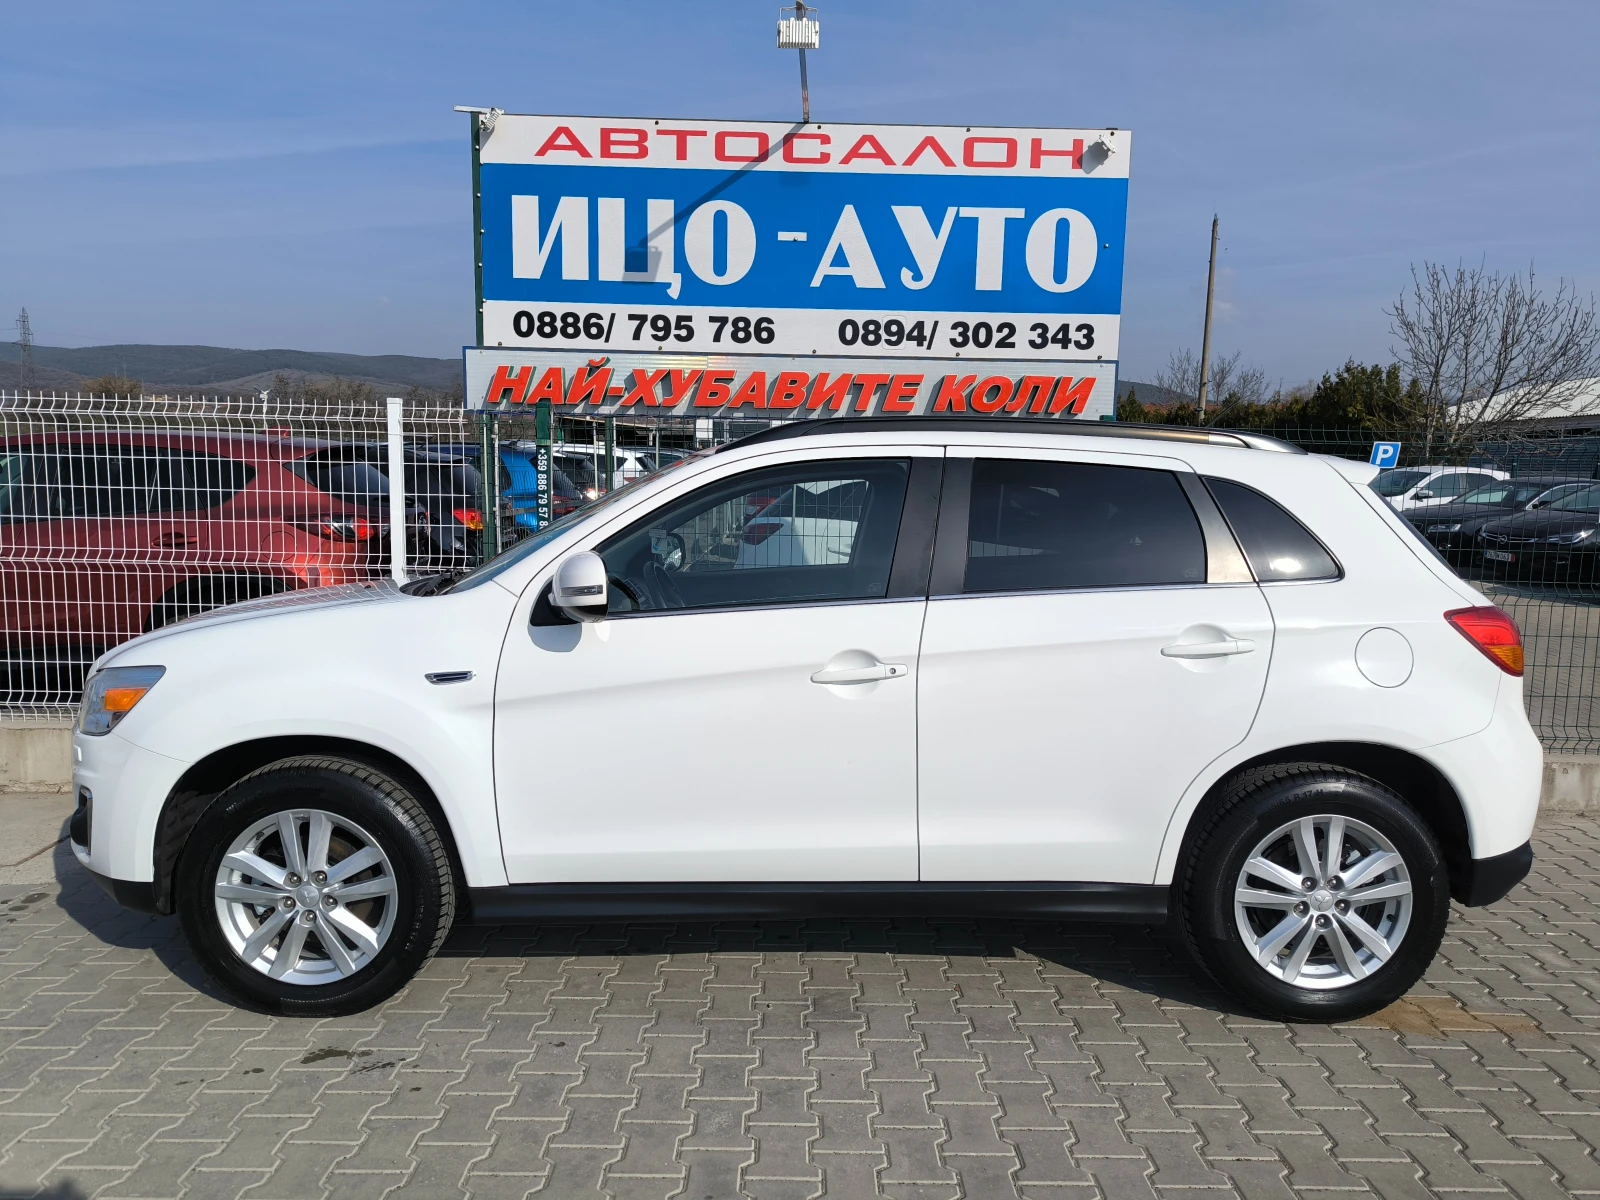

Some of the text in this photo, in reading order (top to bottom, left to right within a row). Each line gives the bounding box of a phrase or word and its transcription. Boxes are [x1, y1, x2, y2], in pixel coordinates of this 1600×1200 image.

[535, 126, 1084, 171] АВТОСАЛОН
[513, 311, 1095, 351] 0886/ 795 786 0894/ 302 343
[486, 356, 1099, 415] НАЙ-ХУБАВИТЕ КОЛИ
[537, 448, 548, 471] +359
[1375, 445, 1394, 465] P
[537, 473, 548, 491] 886
[538, 493, 548, 504] 79
[538, 507, 549, 518] 57
